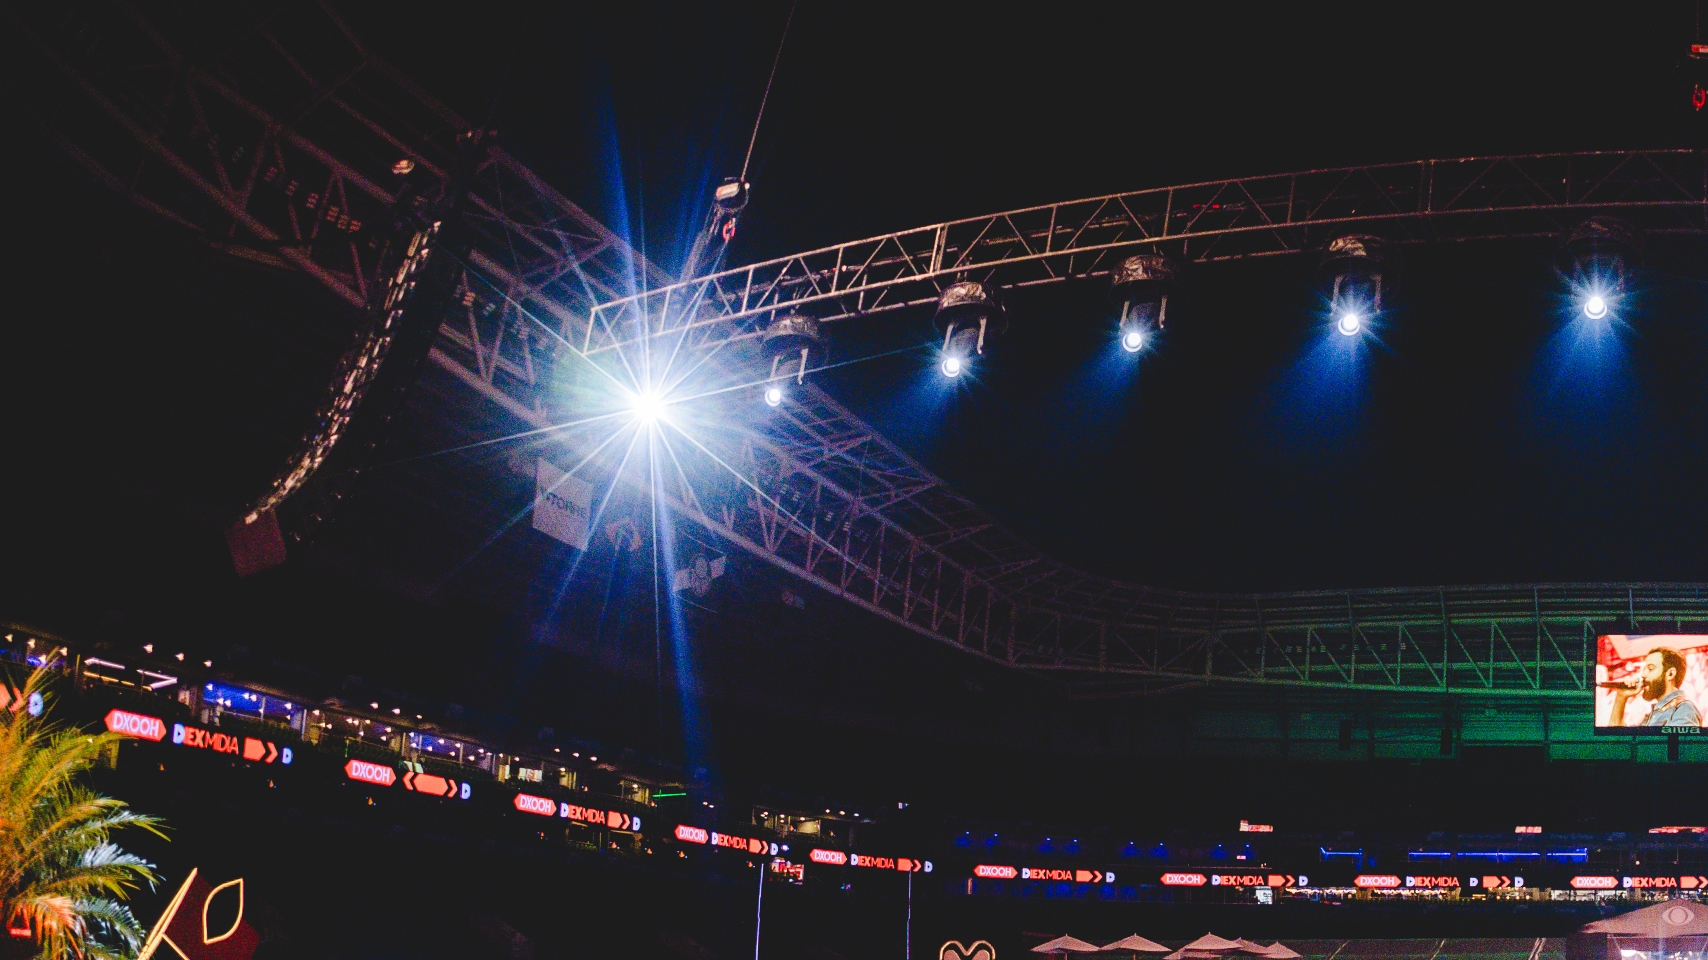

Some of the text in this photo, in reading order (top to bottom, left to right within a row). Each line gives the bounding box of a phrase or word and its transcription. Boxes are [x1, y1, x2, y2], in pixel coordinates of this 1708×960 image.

[1661, 726, 1700, 734] aiwa
[979, 866, 1012, 877] DXOOH
[1166, 874, 1201, 884] DXOOH
[1360, 876, 1395, 886] DXOOH
[1576, 877, 1612, 887] DXOOH
